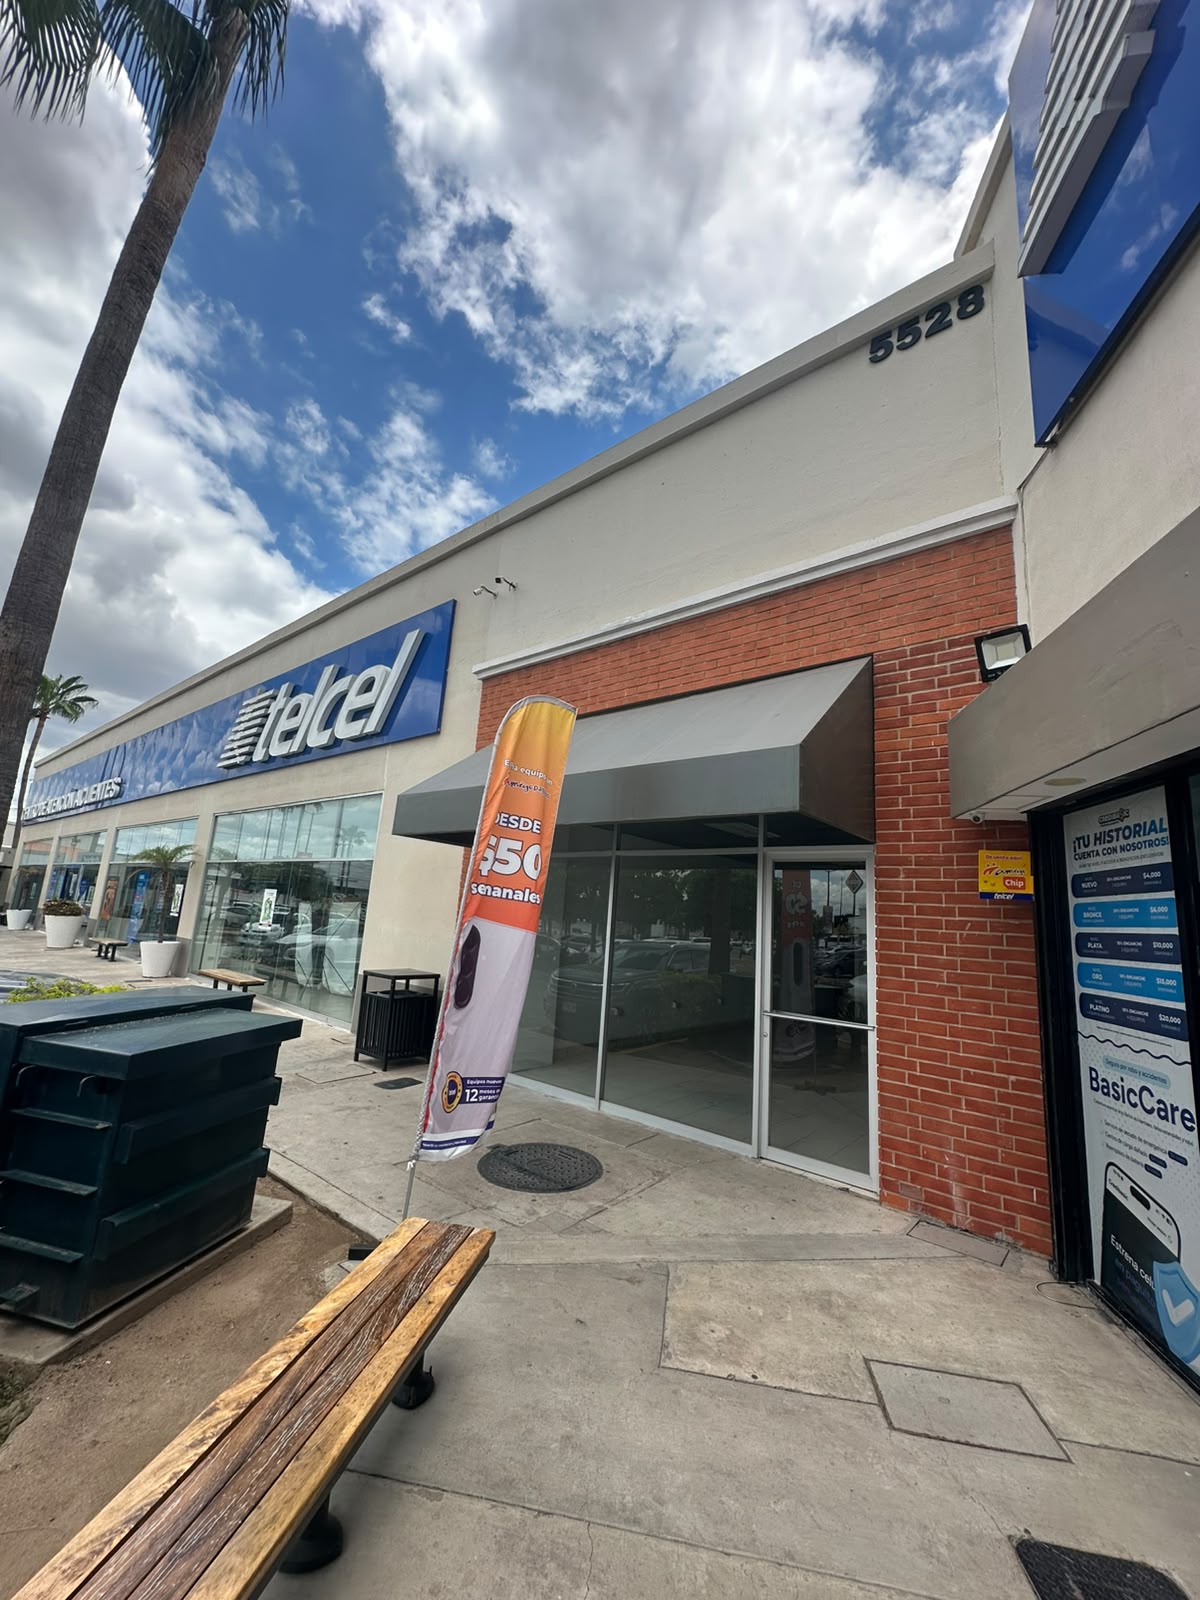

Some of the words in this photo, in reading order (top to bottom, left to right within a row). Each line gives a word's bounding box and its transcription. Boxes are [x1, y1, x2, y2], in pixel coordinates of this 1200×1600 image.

[868, 284, 985, 364] 5528
[252, 628, 427, 763] telcel
[1072, 835, 1091, 853] ¡TU
[1094, 817, 1168, 847] HISTORIAL
[1073, 848, 1100, 861] CUENTA
[1102, 845, 1118, 857] CON
[1119, 835, 1169, 854] NOSOTROS!
[1005, 879, 1024, 888] Chip
[465, 1089, 478, 1102] 12
[1089, 1066, 1196, 1132] BasicCare
[1110, 1234, 1139, 1272] Estrena
